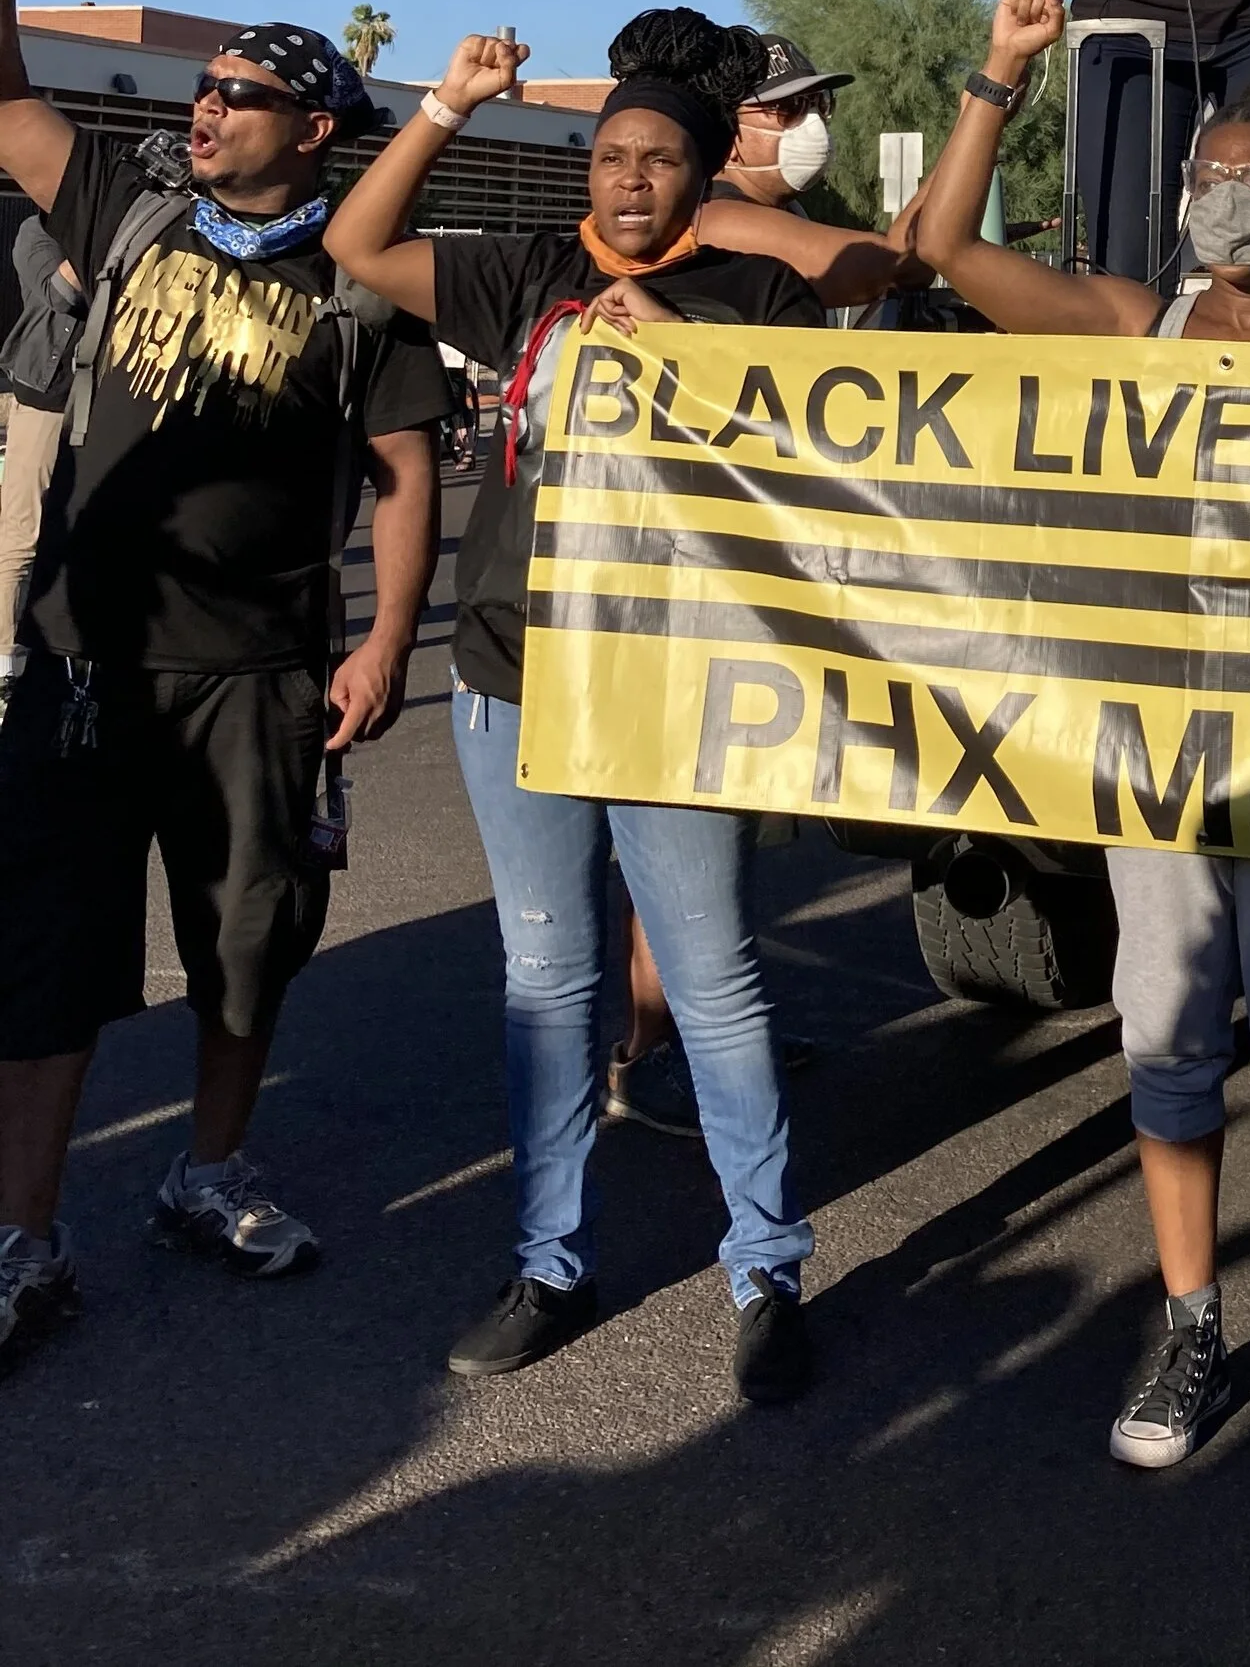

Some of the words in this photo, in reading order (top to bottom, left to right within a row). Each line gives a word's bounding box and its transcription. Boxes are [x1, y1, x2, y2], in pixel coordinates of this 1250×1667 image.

[118, 243, 322, 369] MELANIN
[565, 344, 973, 470] BLACK
[693, 657, 1038, 827] PHX
